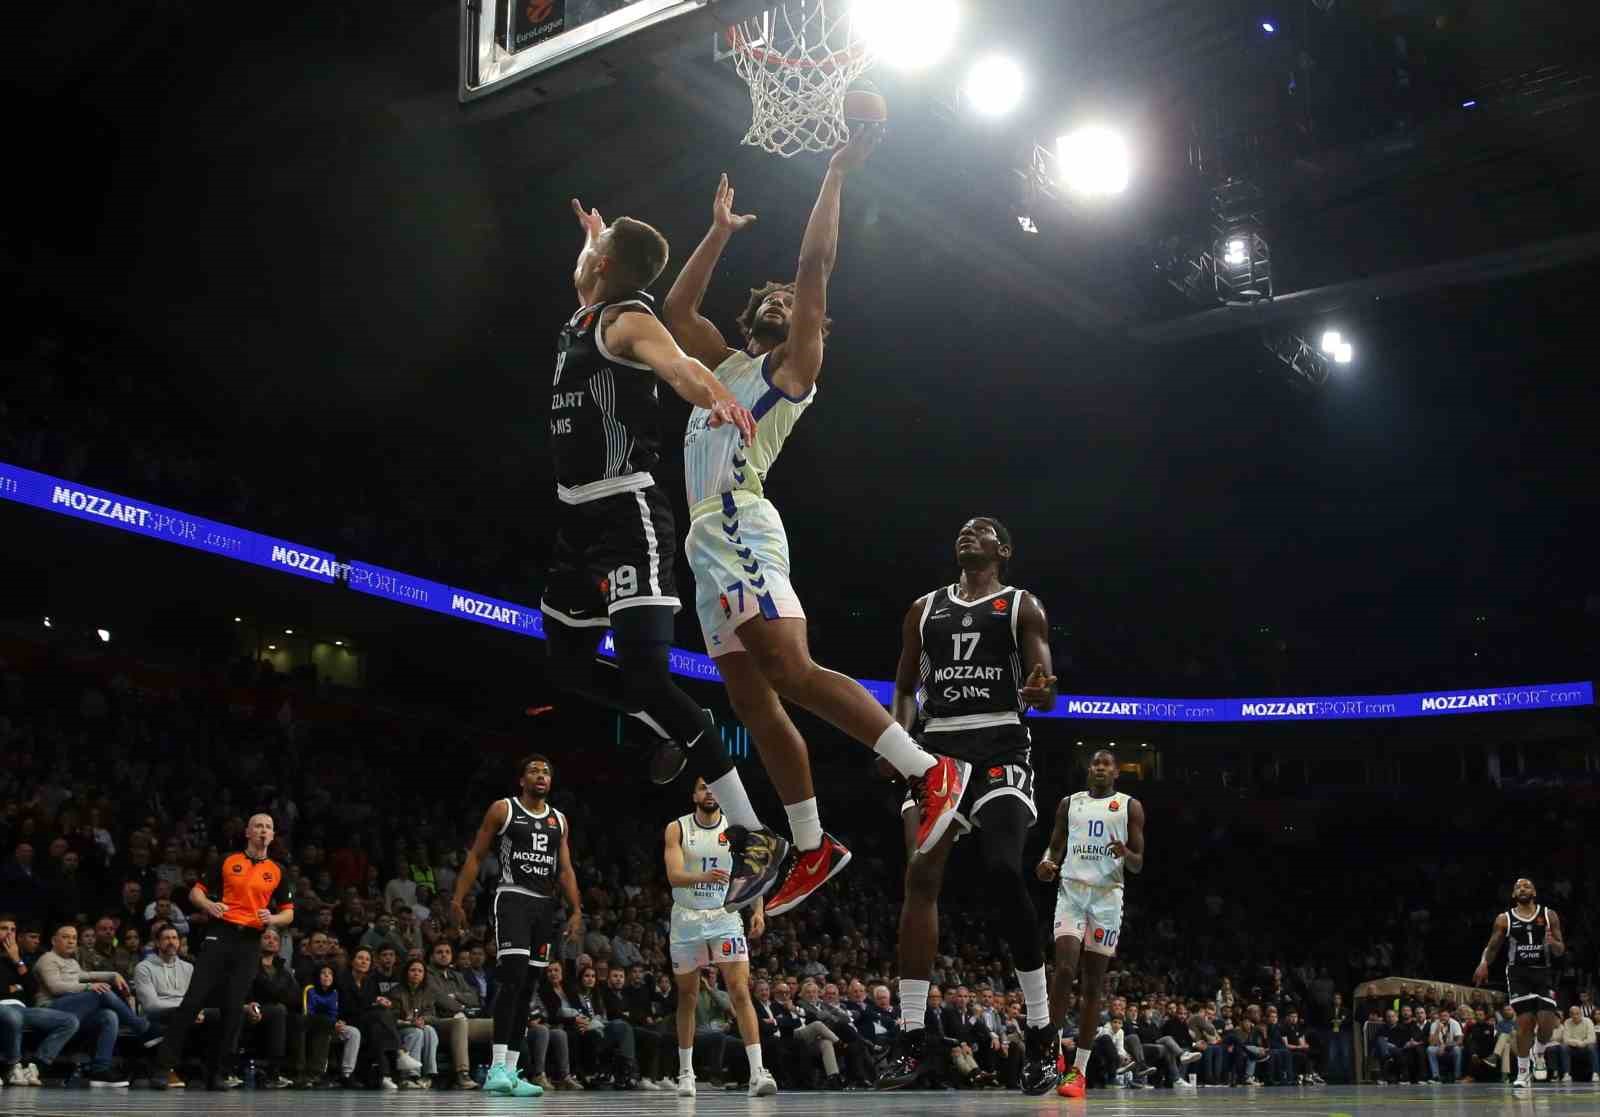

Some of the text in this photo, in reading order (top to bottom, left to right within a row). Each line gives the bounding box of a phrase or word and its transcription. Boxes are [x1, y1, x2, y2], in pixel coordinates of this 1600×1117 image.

[552, 391, 585, 410] ZZART
[607, 565, 638, 600] 19
[727, 581, 744, 613] 7
[951, 632, 981, 661] 17
[934, 666, 1003, 684] MOZZART
[1003, 764, 1026, 790] 17
[1088, 820, 1104, 837] 10
[531, 832, 549, 852] 12
[1072, 844, 1113, 857] VALENCIA
[732, 937, 746, 954] 13
[1103, 930, 1116, 947] 10
[1527, 931, 1533, 945] 1
